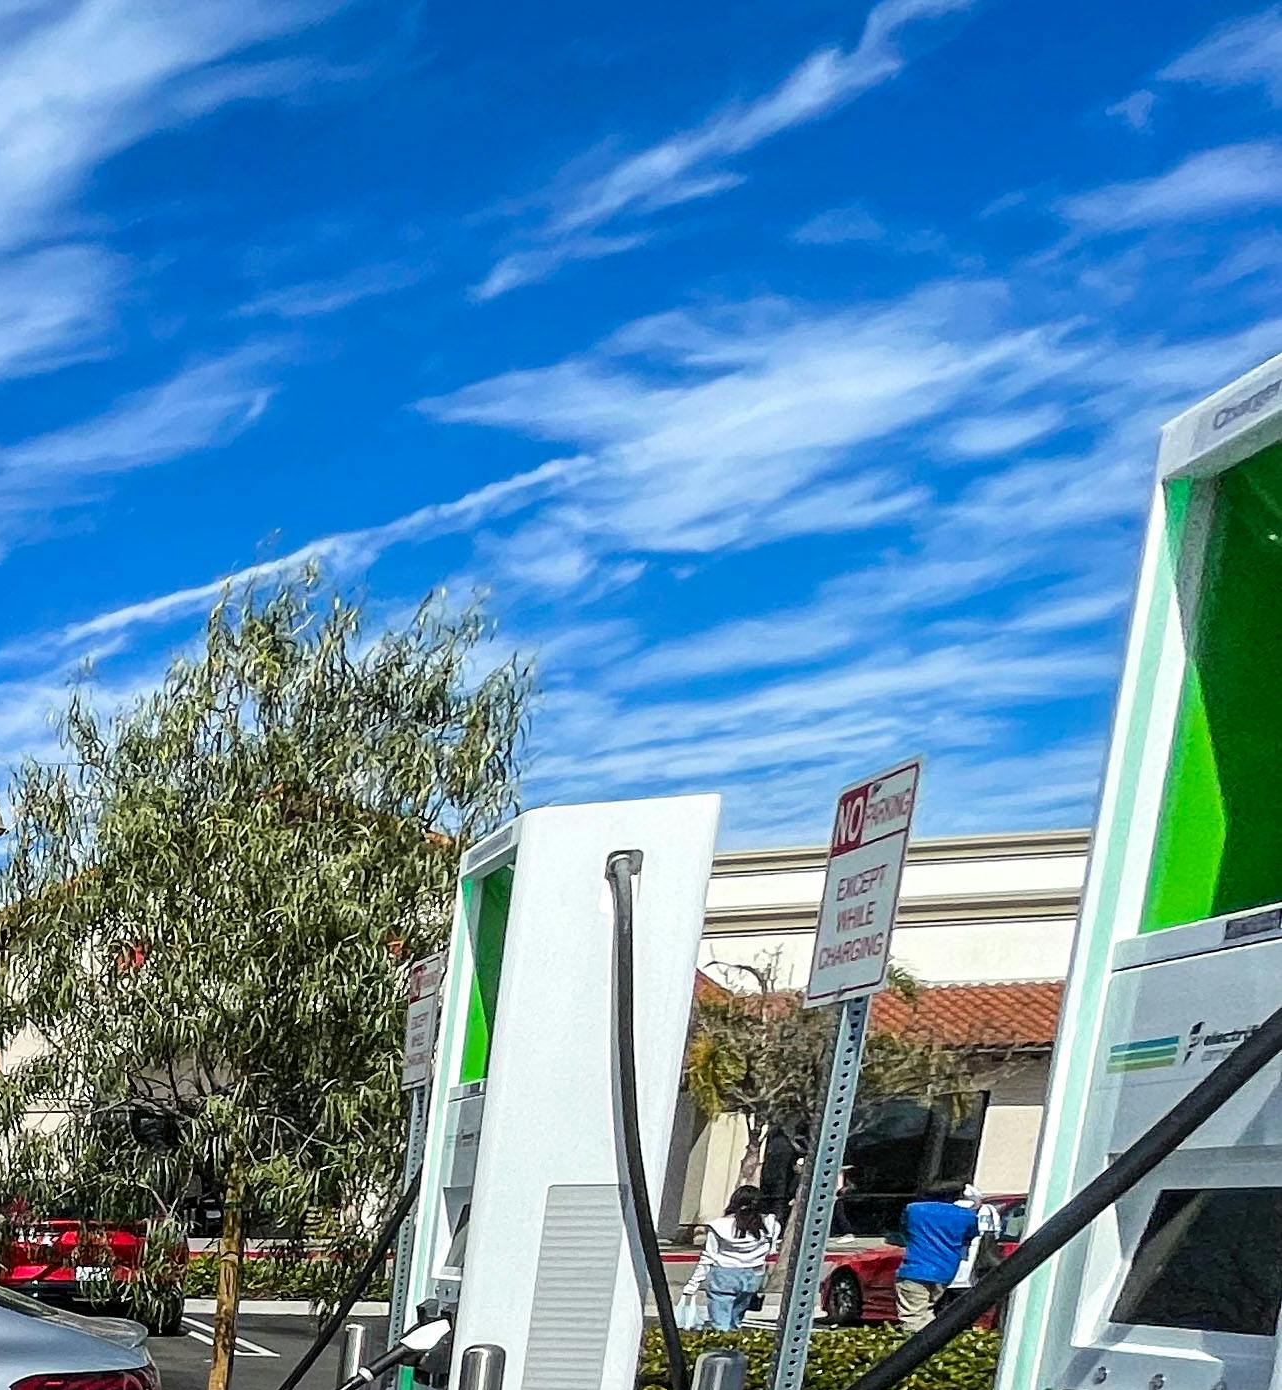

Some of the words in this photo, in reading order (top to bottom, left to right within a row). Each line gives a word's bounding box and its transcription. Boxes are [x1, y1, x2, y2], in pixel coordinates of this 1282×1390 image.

[837, 796, 864, 847] NO
[837, 863, 888, 901] EXCEPT
[836, 901, 875, 933] WHILE
[818, 932, 885, 971] CHARGING
